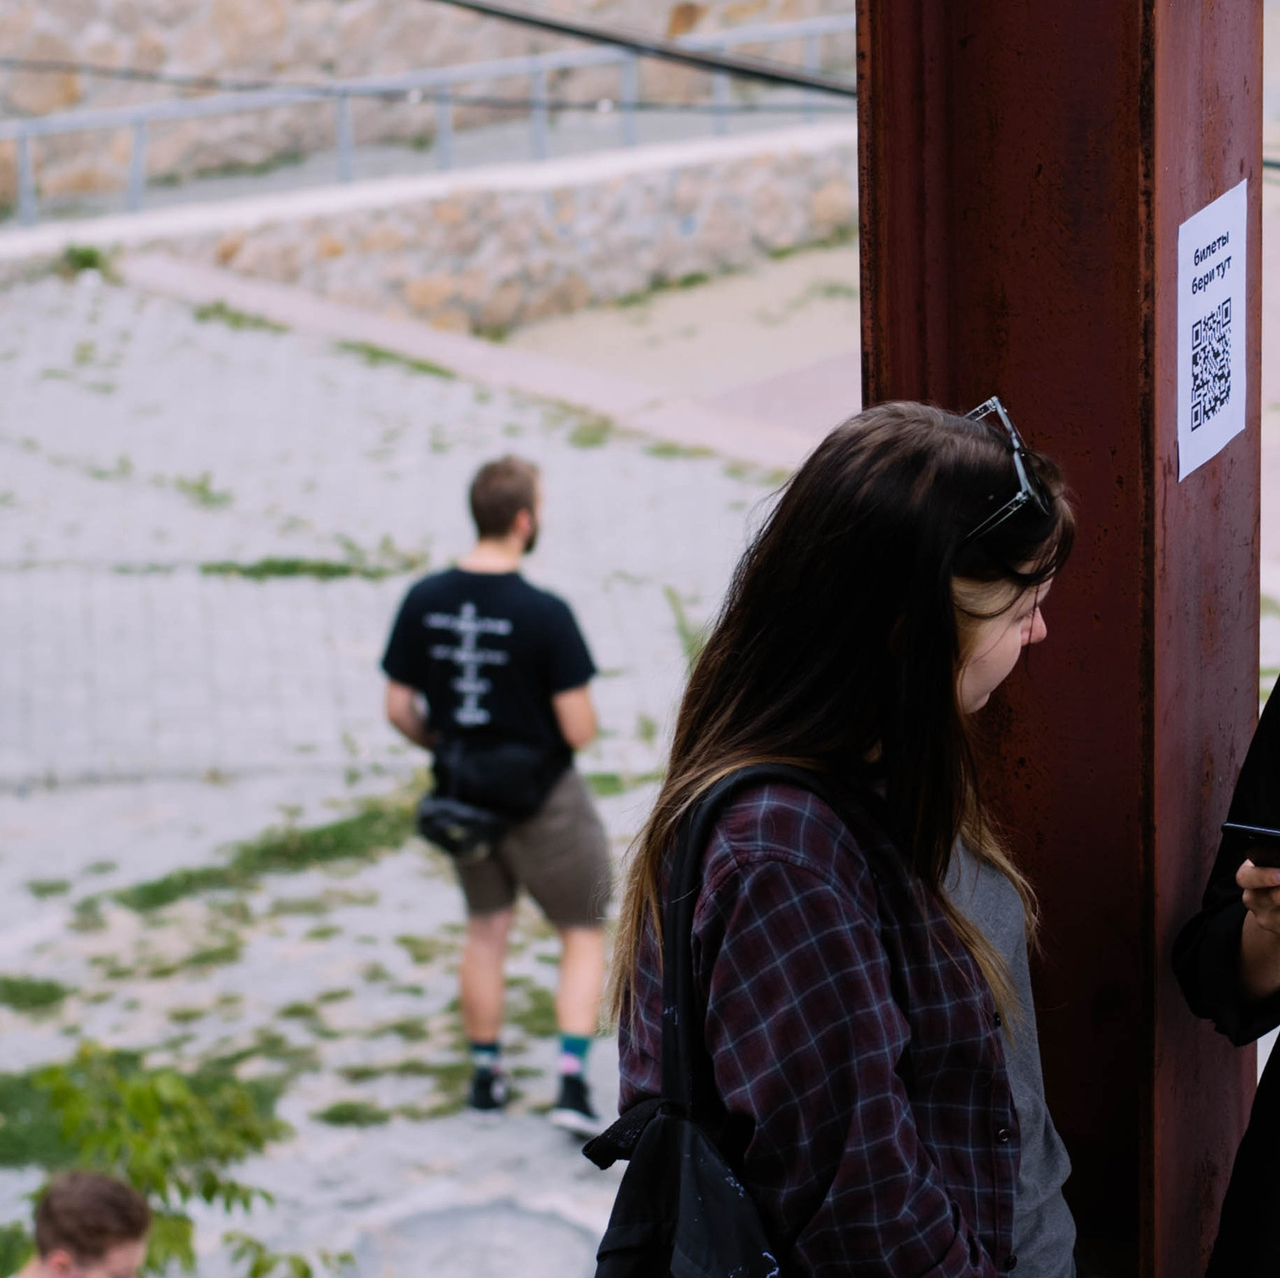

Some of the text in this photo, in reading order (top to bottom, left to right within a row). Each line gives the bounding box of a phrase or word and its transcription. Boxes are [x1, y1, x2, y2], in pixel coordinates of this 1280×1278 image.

[1194, 231, 1229, 266] билеты
[1191, 256, 1231, 295] бери тут
